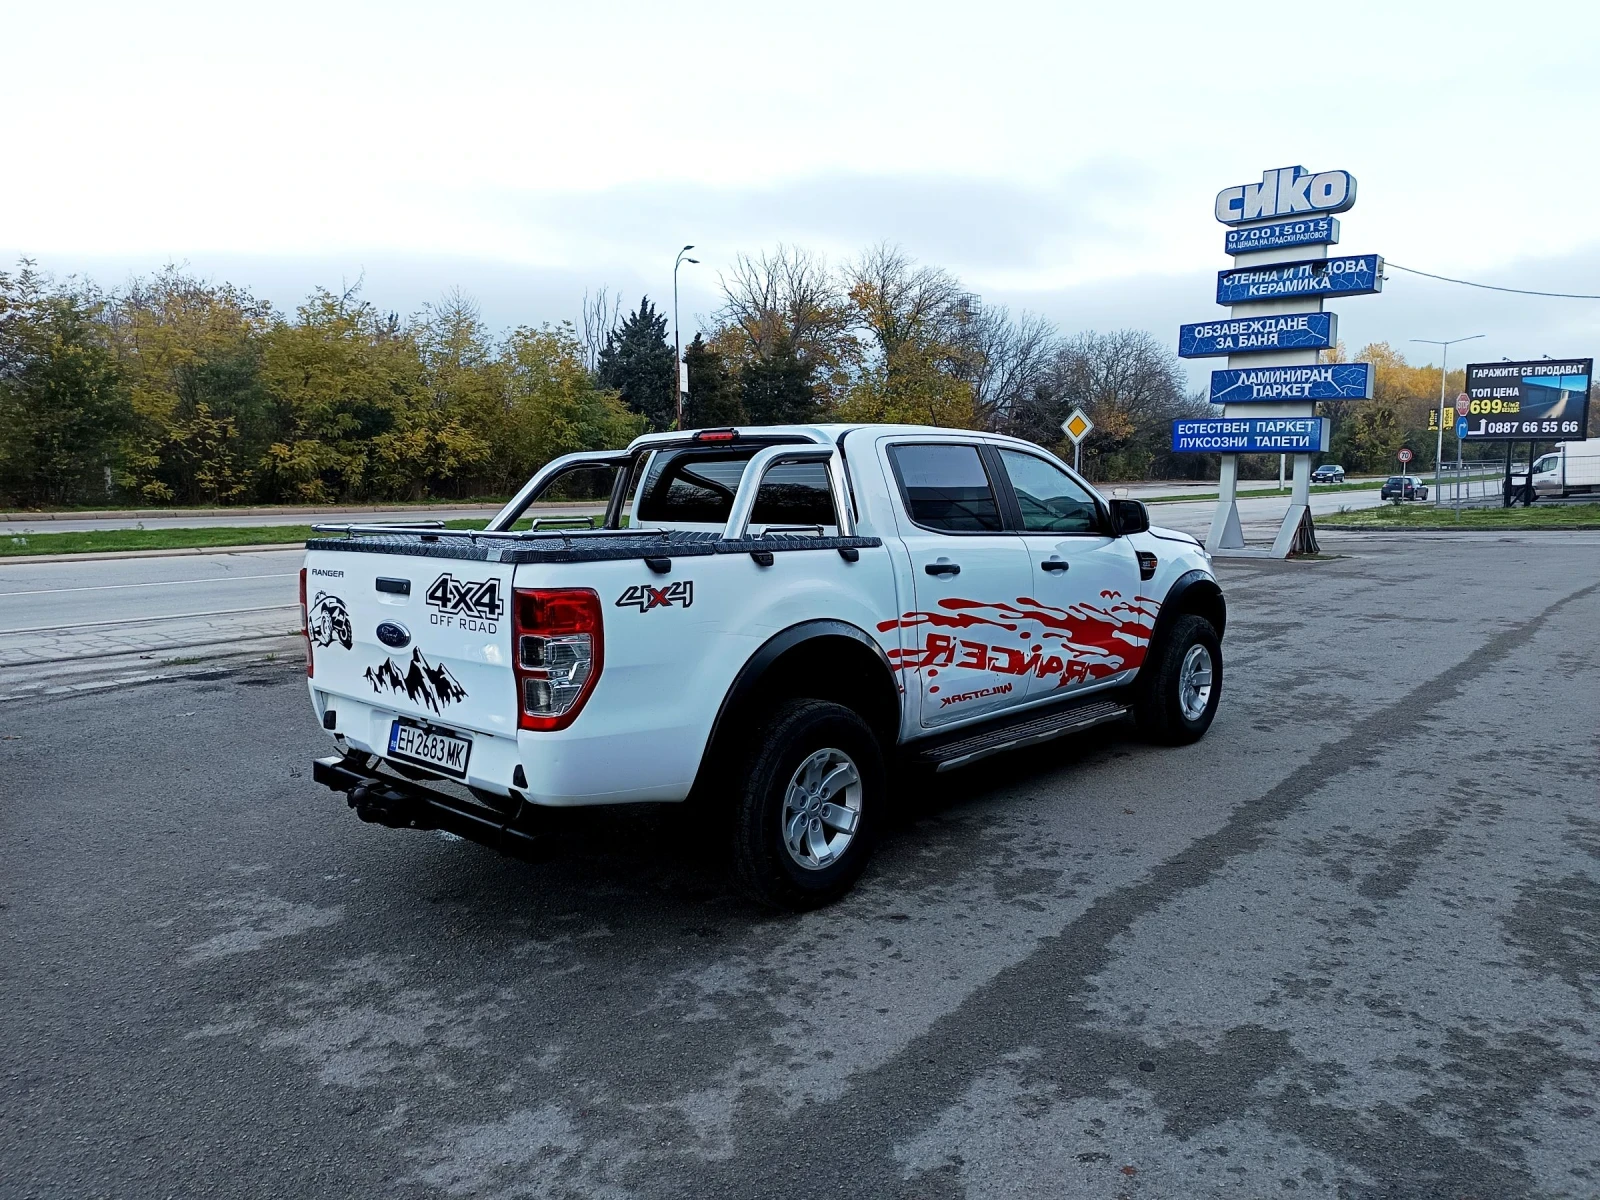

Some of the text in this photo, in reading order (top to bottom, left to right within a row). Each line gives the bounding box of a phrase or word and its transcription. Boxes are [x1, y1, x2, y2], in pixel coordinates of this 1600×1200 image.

[1229, 221, 1328, 242] 070015015
[1238, 239, 1259, 249] ЦЕНАТА
[1260, 238, 1268, 246] НА
[1269, 234, 1295, 245] ГРАДСКИ
[1296, 231, 1328, 242] РАЗГОВОР
[1224, 259, 1368, 286] СТЕННА И ПДОВА
[1249, 277, 1332, 296] КЕРАМИКА
[1194, 317, 1308, 338] ОБЗАВЕЖДАНЕ
[1216, 333, 1278, 349] ЗА БАНЯ
[1239, 368, 1332, 386] ЛАМИНИРАН
[1472, 364, 1584, 378] ГАРАЖИТЕ СЕ ПРОДАВАТ
[1252, 383, 1312, 398] ПАРКЕТ
[1471, 387, 1519, 399] ТОП ЦЕНА
[1457, 400, 1469, 409] STOP
[1470, 399, 1502, 414] 699
[1178, 421, 1315, 434] ЕСТЕСТВЕН ПАРКЕТ
[1488, 421, 1578, 433] 0887 66 55 66
[1179, 435, 1310, 448] ЛУКСОЗНИ ТАПЕТИ
[311, 568, 344, 578] RANGER
[430, 613, 497, 634] OFF ROAD
